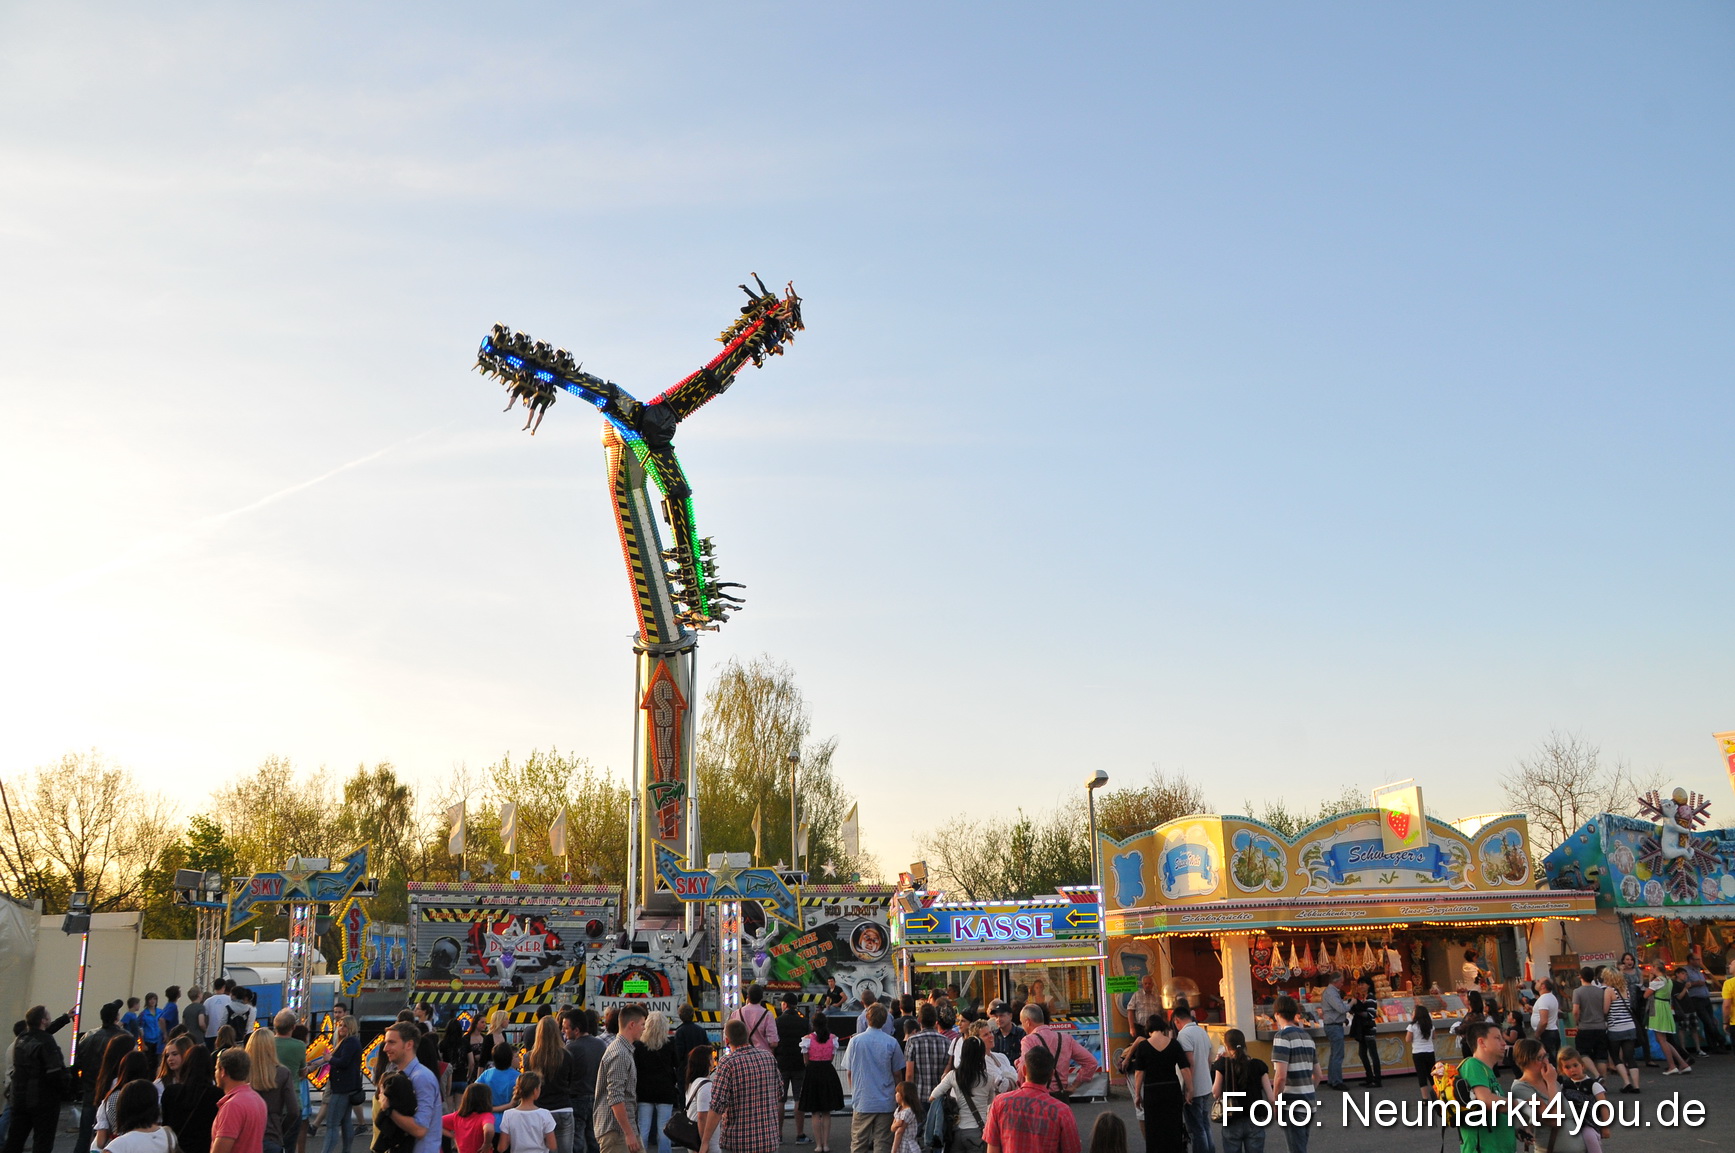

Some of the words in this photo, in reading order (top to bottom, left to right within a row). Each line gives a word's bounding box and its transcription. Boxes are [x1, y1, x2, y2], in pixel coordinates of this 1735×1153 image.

[653, 679, 674, 782] SKY
[647, 779, 686, 810] Trip
[250, 878, 282, 896] SKY
[675, 876, 710, 895] SKY
[744, 874, 778, 895] Trip
[482, 897, 518, 905] WARNING
[1511, 902, 1571, 911] Kokosmakronen
[824, 905, 841, 917] NO
[844, 904, 880, 917] LIMIT
[1295, 908, 1367, 919] Lebkuchenherzen
[349, 908, 360, 962] SKY
[953, 914, 1054, 942] KASSE
[490, 941, 541, 952] DGER
[792, 932, 819, 949] TAKE
[796, 945, 818, 960] YOU
[818, 940, 834, 953] TO
[787, 965, 807, 979] THE
[601, 1001, 671, 1012] HARANN
[1002, 1096, 1059, 1121] TOKYO
